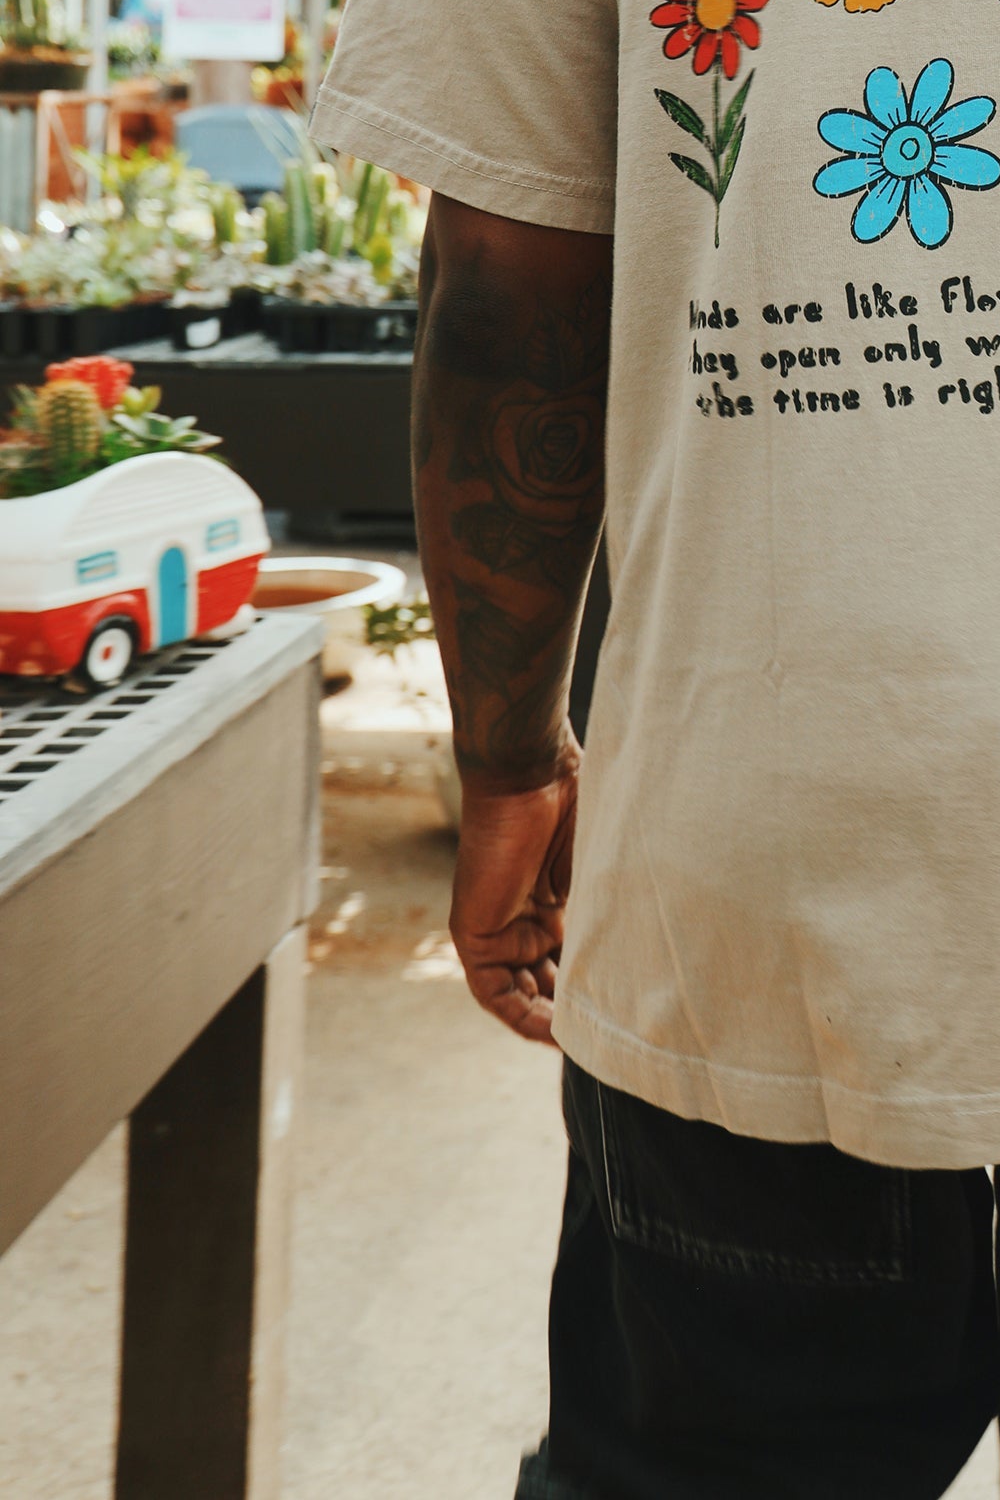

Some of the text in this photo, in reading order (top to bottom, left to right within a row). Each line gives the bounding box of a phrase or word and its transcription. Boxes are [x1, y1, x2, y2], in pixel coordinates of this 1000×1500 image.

[762, 300, 823, 325] are
[845, 282, 918, 319] like
[688, 338, 739, 380] hey
[760, 345, 840, 378] open
[864, 323, 942, 368] only
[773, 387, 860, 414] time
[883, 382, 914, 408] is
